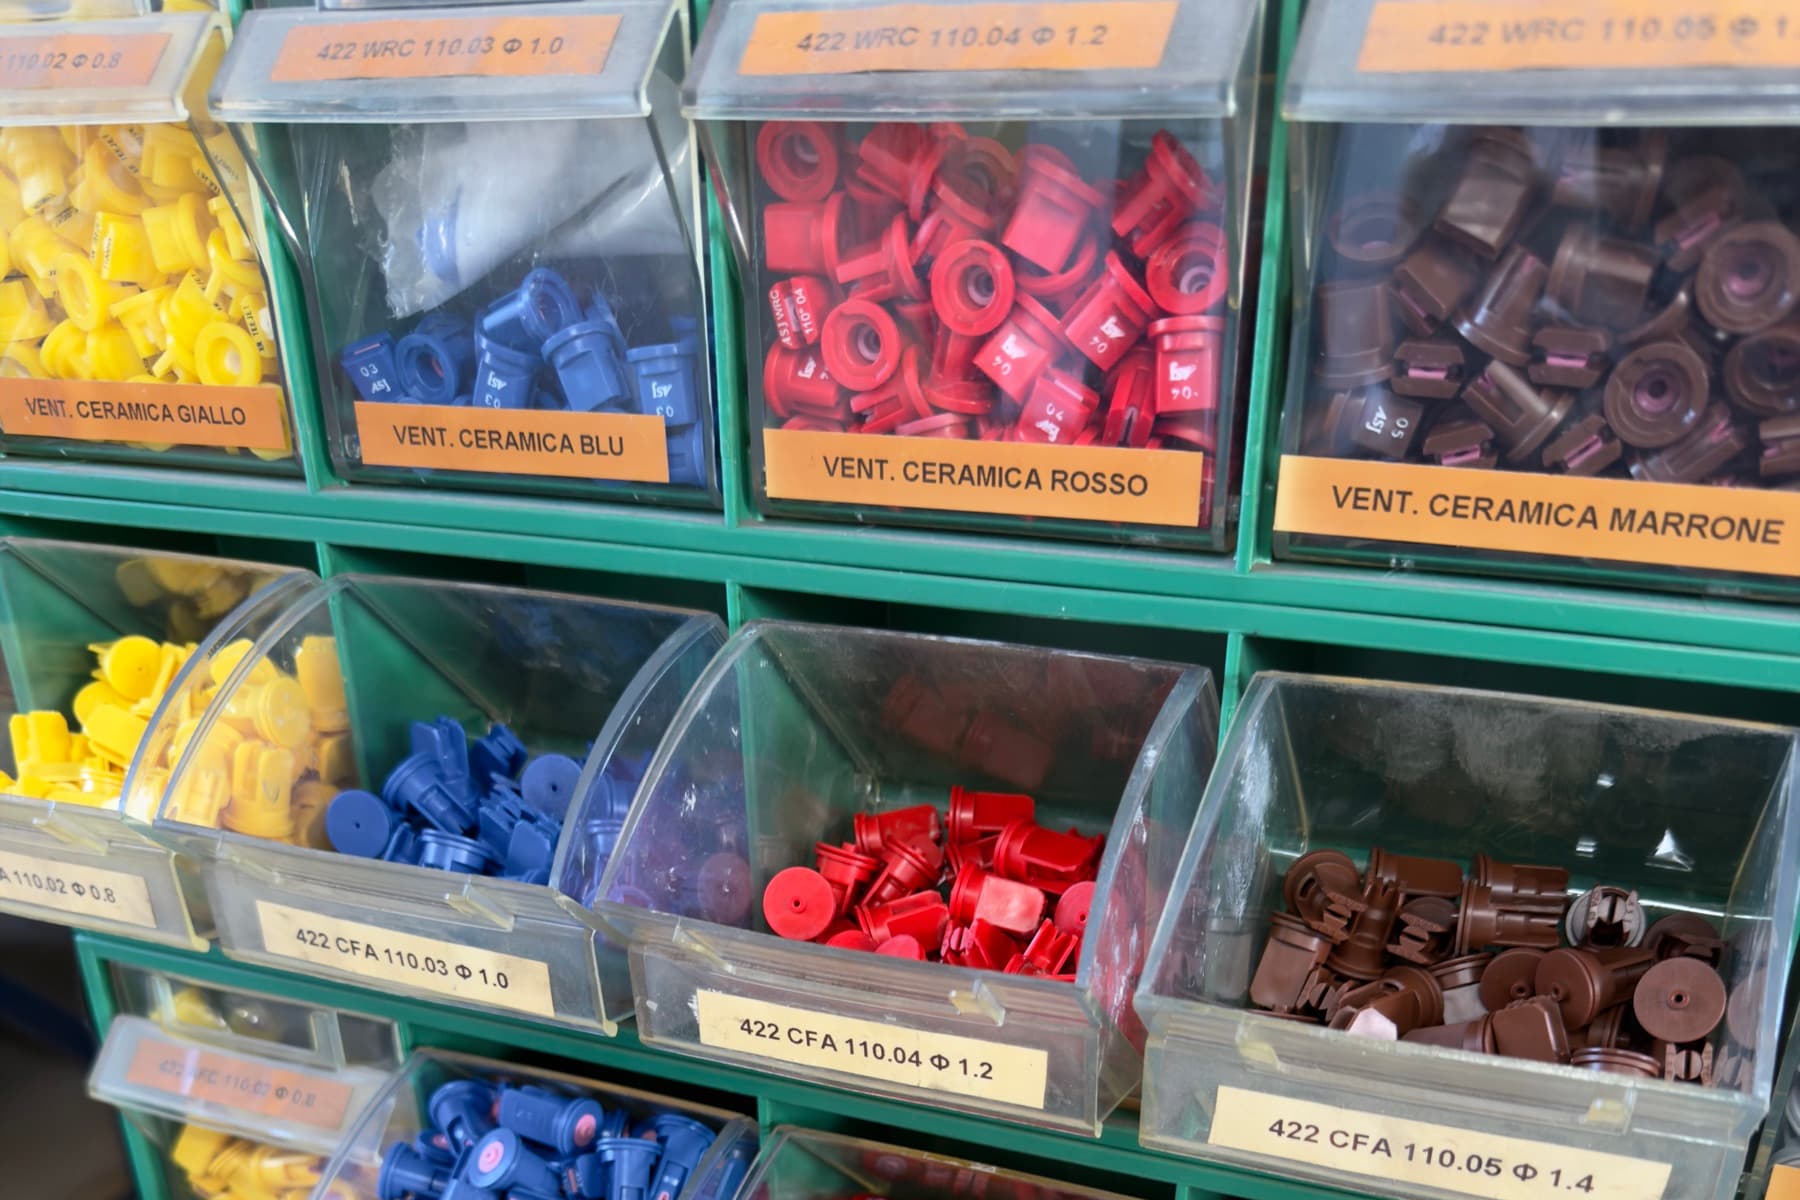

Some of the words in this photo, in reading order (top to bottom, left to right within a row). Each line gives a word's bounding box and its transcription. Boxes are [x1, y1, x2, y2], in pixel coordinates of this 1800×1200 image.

[318, 41, 357, 60] 422
[362, 39, 414, 59] WRC
[424, 36, 494, 57] 110.03
[529, 35, 563, 55] 1.0
[798, 31, 846, 52] 422
[852, 28, 918, 49] WRC
[931, 27, 1020, 47] 110.04
[1069, 25, 1107, 45] 1.2
[1429, 23, 1490, 45] 422
[1500, 19, 1585, 43] WRC
[92, 52, 122, 69] 0.8
[25, 397, 74, 419] VENT.
[76, 400, 174, 424] CERAMICA
[178, 404, 246, 426] GIALLO
[392, 425, 454, 448] VENT.
[459, 428, 575, 454] CERAMICA
[580, 435, 624, 456] BLU
[823, 456, 895, 482] VENT.
[903, 461, 1042, 490] CERAMICA
[1050, 470, 1148, 497] ROSSO
[1332, 486, 1419, 516] VENT.
[1428, 493, 1599, 530] CERAMICA
[1608, 507, 1785, 545] MARRONE
[16, 872, 69, 895] 110.02
[89, 884, 116, 905] 0.8
[296, 929, 331, 951] 422
[336, 936, 379, 961] CFA
[385, 947, 449, 977] 110.03
[479, 967, 509, 990] 1.0
[740, 1018, 780, 1041] 422
[787, 1028, 838, 1052] CFA
[845, 1038, 922, 1068] 110.04
[958, 1057, 993, 1081] 1.2
[1268, 1118, 1320, 1144] 422
[1328, 1129, 1393, 1158] CFA
[1403, 1143, 1503, 1178] 110.05
[1549, 1168, 1595, 1194] 1.4
